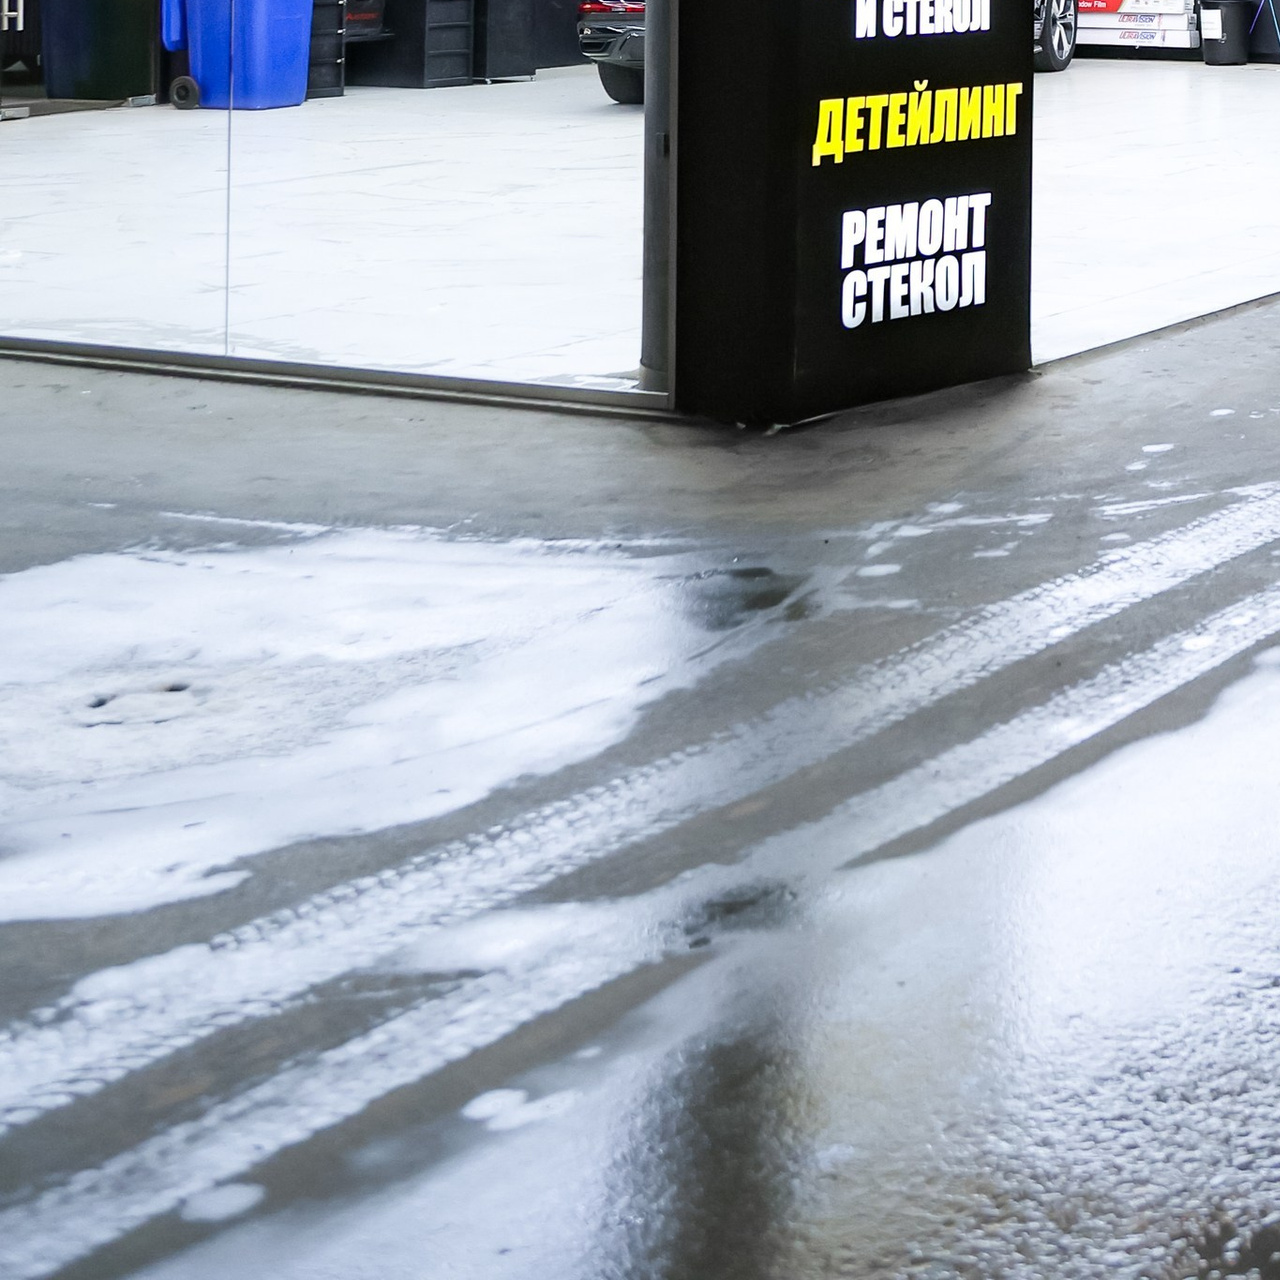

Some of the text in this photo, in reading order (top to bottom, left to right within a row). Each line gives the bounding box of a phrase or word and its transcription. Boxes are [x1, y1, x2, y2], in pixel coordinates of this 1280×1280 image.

[811, 79, 1023, 167] ДЕТЕЙЛИНГ
[840, 192, 992, 269] РЕМОНТ
[840, 250, 987, 329] СТЕКОЛ
